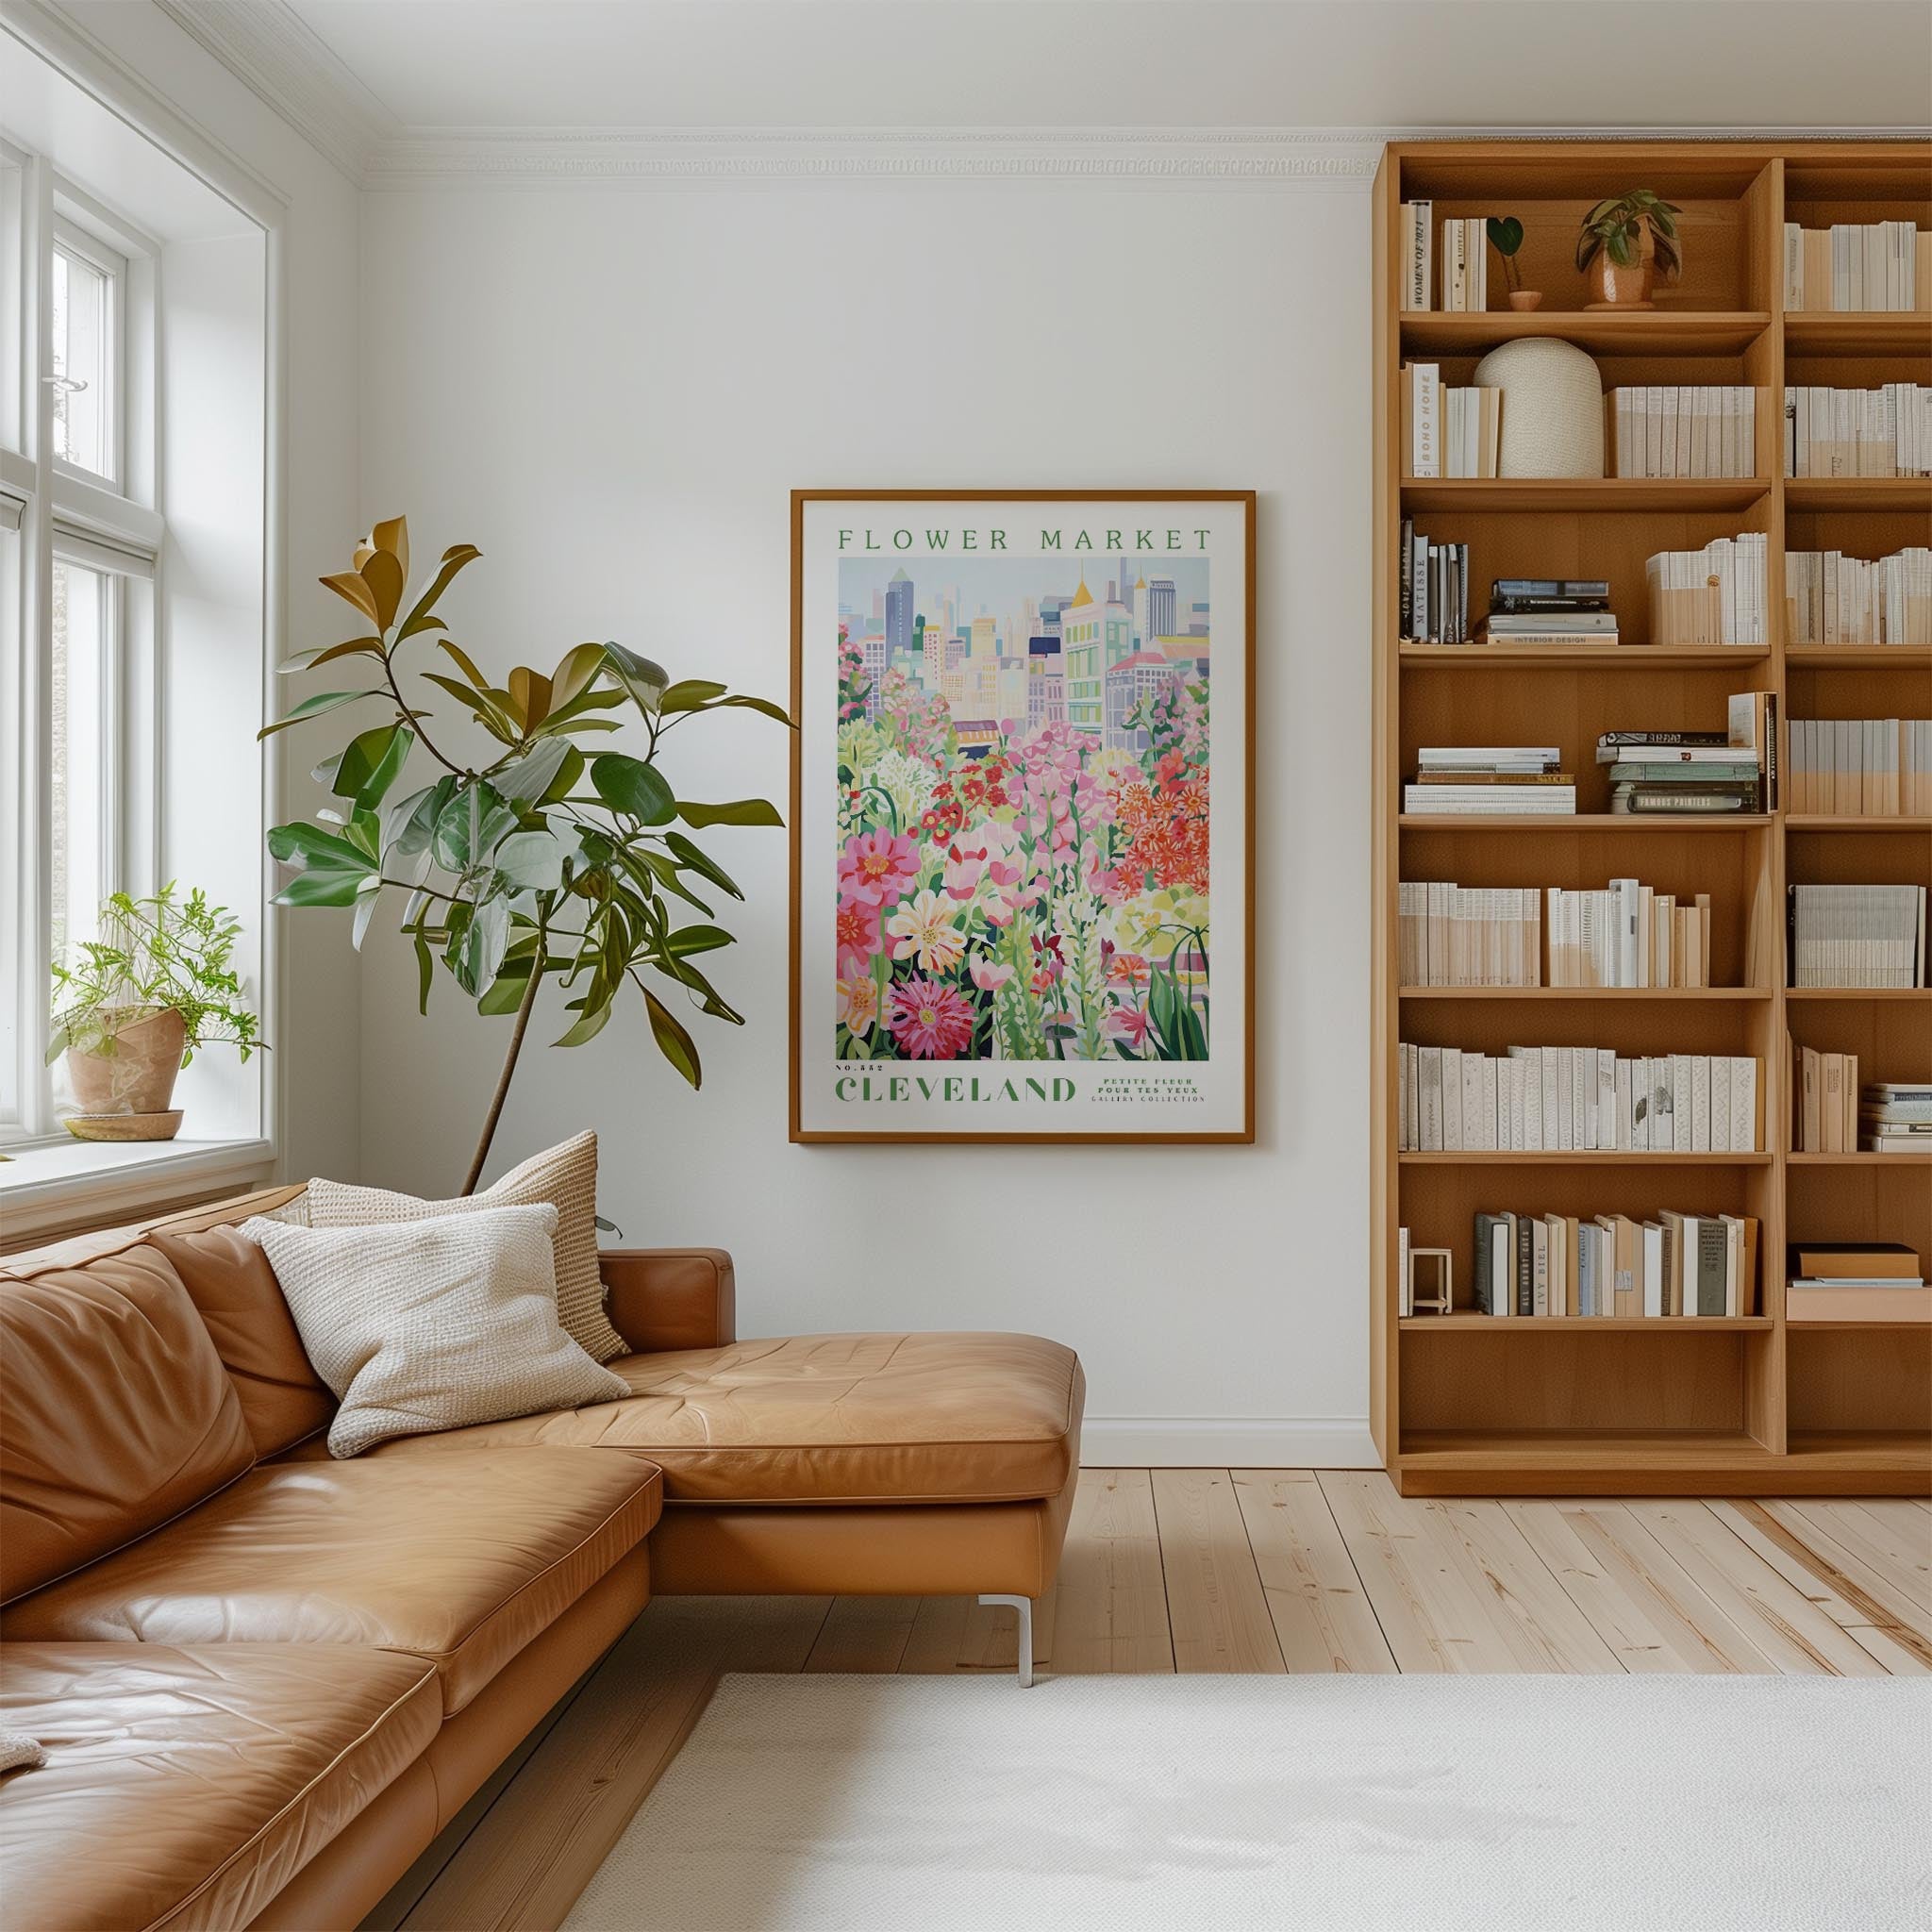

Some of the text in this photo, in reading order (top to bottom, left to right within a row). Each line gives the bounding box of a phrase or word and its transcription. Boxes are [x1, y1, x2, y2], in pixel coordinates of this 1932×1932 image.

[1415, 244, 1424, 259] OF
[1414, 263, 1424, 306] WOMEN
[1422, 375, 1430, 415] HOME
[1422, 422, 1430, 461] BOHO
[838, 529, 1212, 550] FLOWER MARKET
[1416, 559, 1424, 624] MATISSE
[1640, 798, 1711, 807] FAMOUS PAINTERS
[835, 1076, 1076, 1102] CLEVELAND
[1538, 1245, 1546, 1275] BIEL
